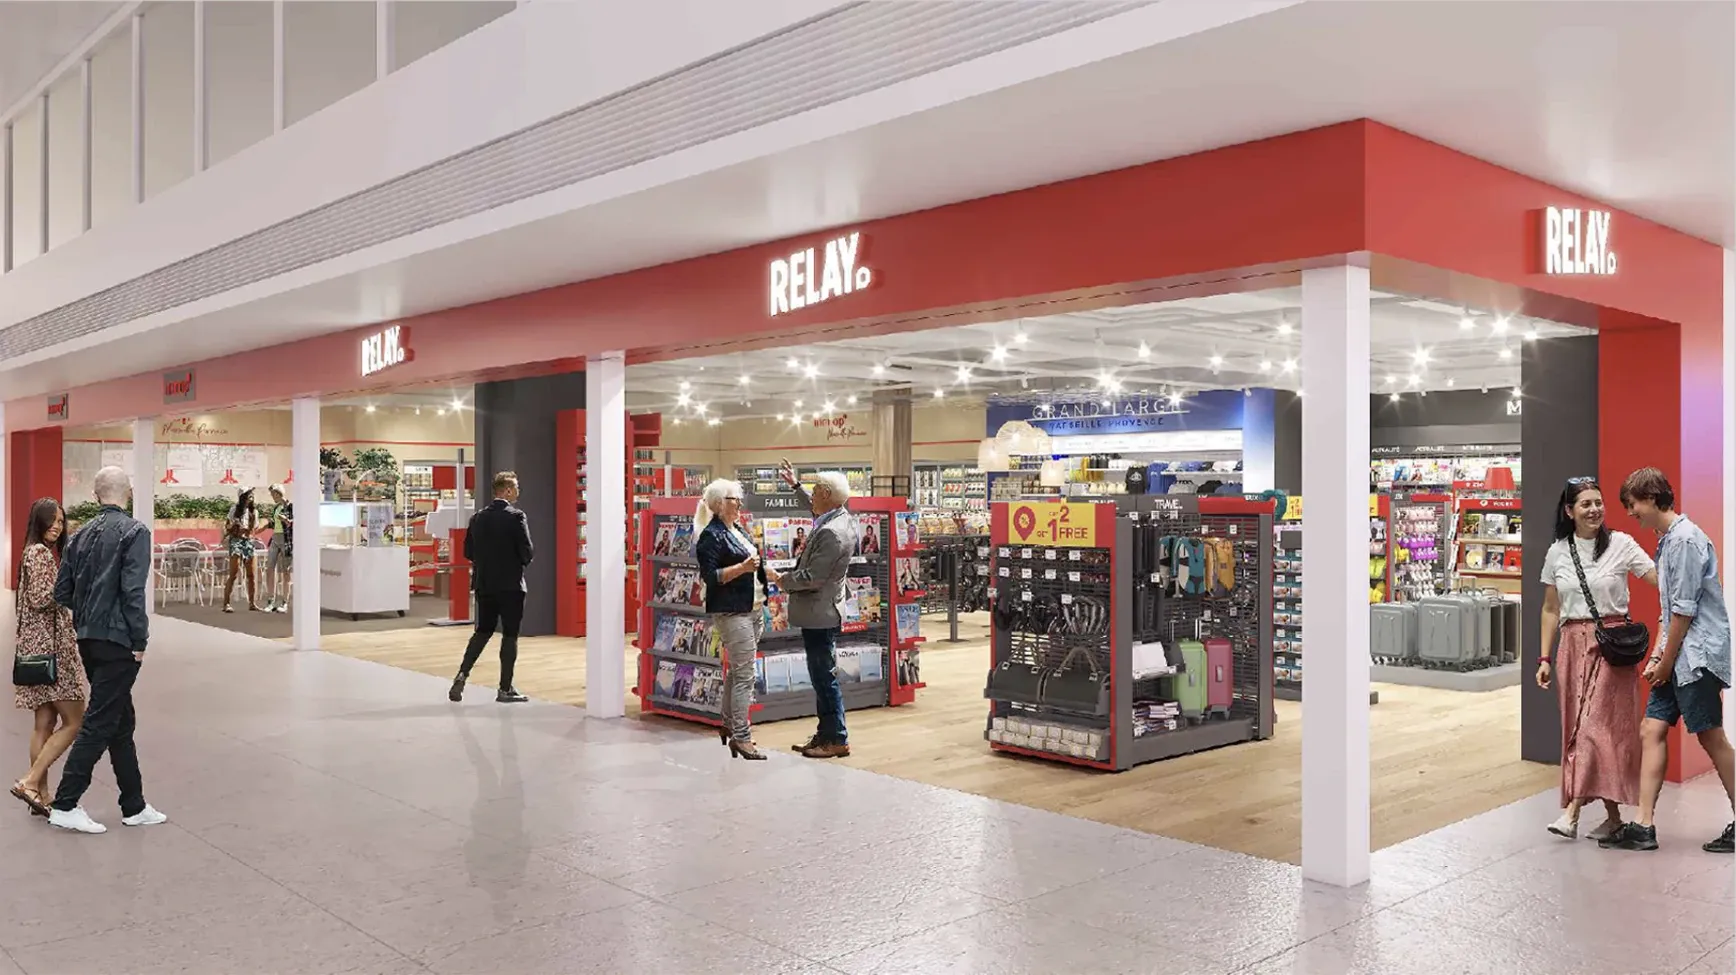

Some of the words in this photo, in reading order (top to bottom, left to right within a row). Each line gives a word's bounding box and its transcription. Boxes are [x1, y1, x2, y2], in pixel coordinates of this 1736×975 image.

[1546, 206, 1611, 274] RELAY
[769, 231, 860, 317] RELAY
[361, 325, 401, 377] RELAY
[764, 498, 799, 508] FAMILLE
[1059, 505, 1070, 523] 2
[1047, 518, 1057, 542] 1
[1059, 527, 1088, 540] FREE
